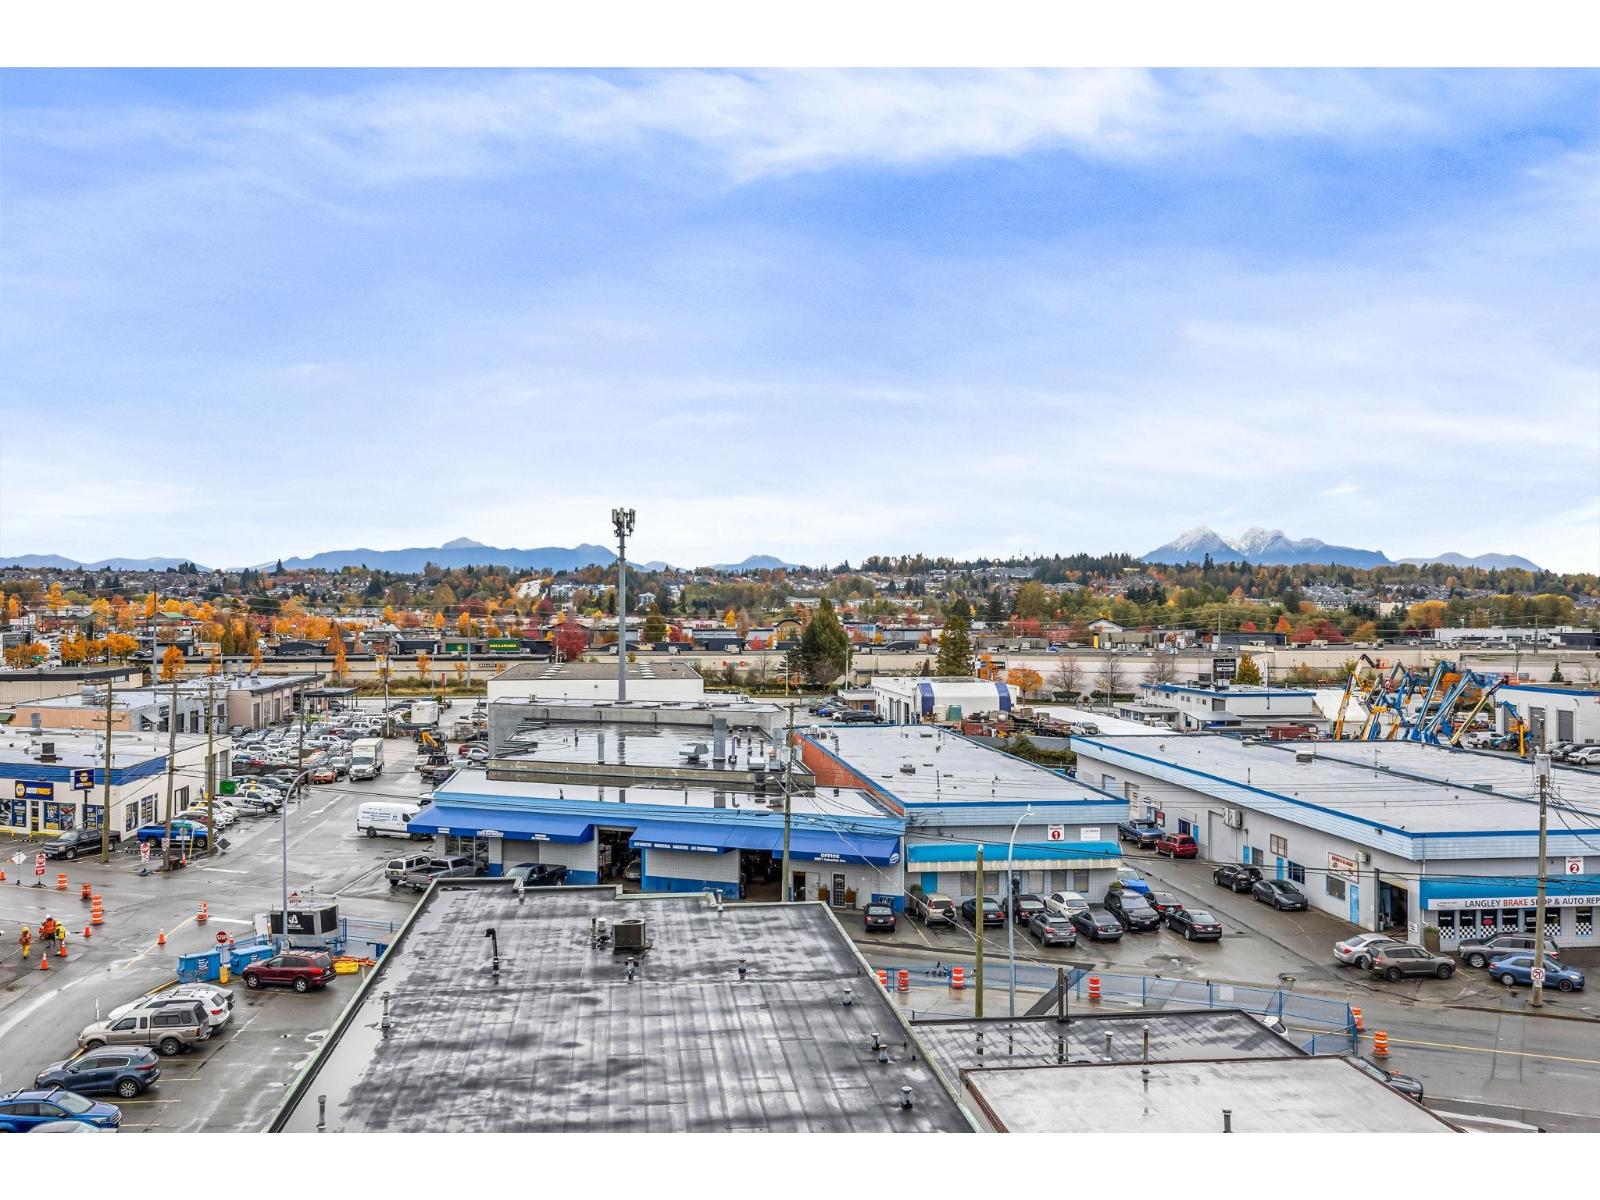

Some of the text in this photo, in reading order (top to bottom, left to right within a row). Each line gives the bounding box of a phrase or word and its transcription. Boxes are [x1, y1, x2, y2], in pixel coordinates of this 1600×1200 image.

[1465, 899, 1500, 908] LANGLEY
[1503, 899, 1528, 907] BRAKE
[1530, 898, 1553, 906] SP
[1562, 897, 1584, 905] AUTO
